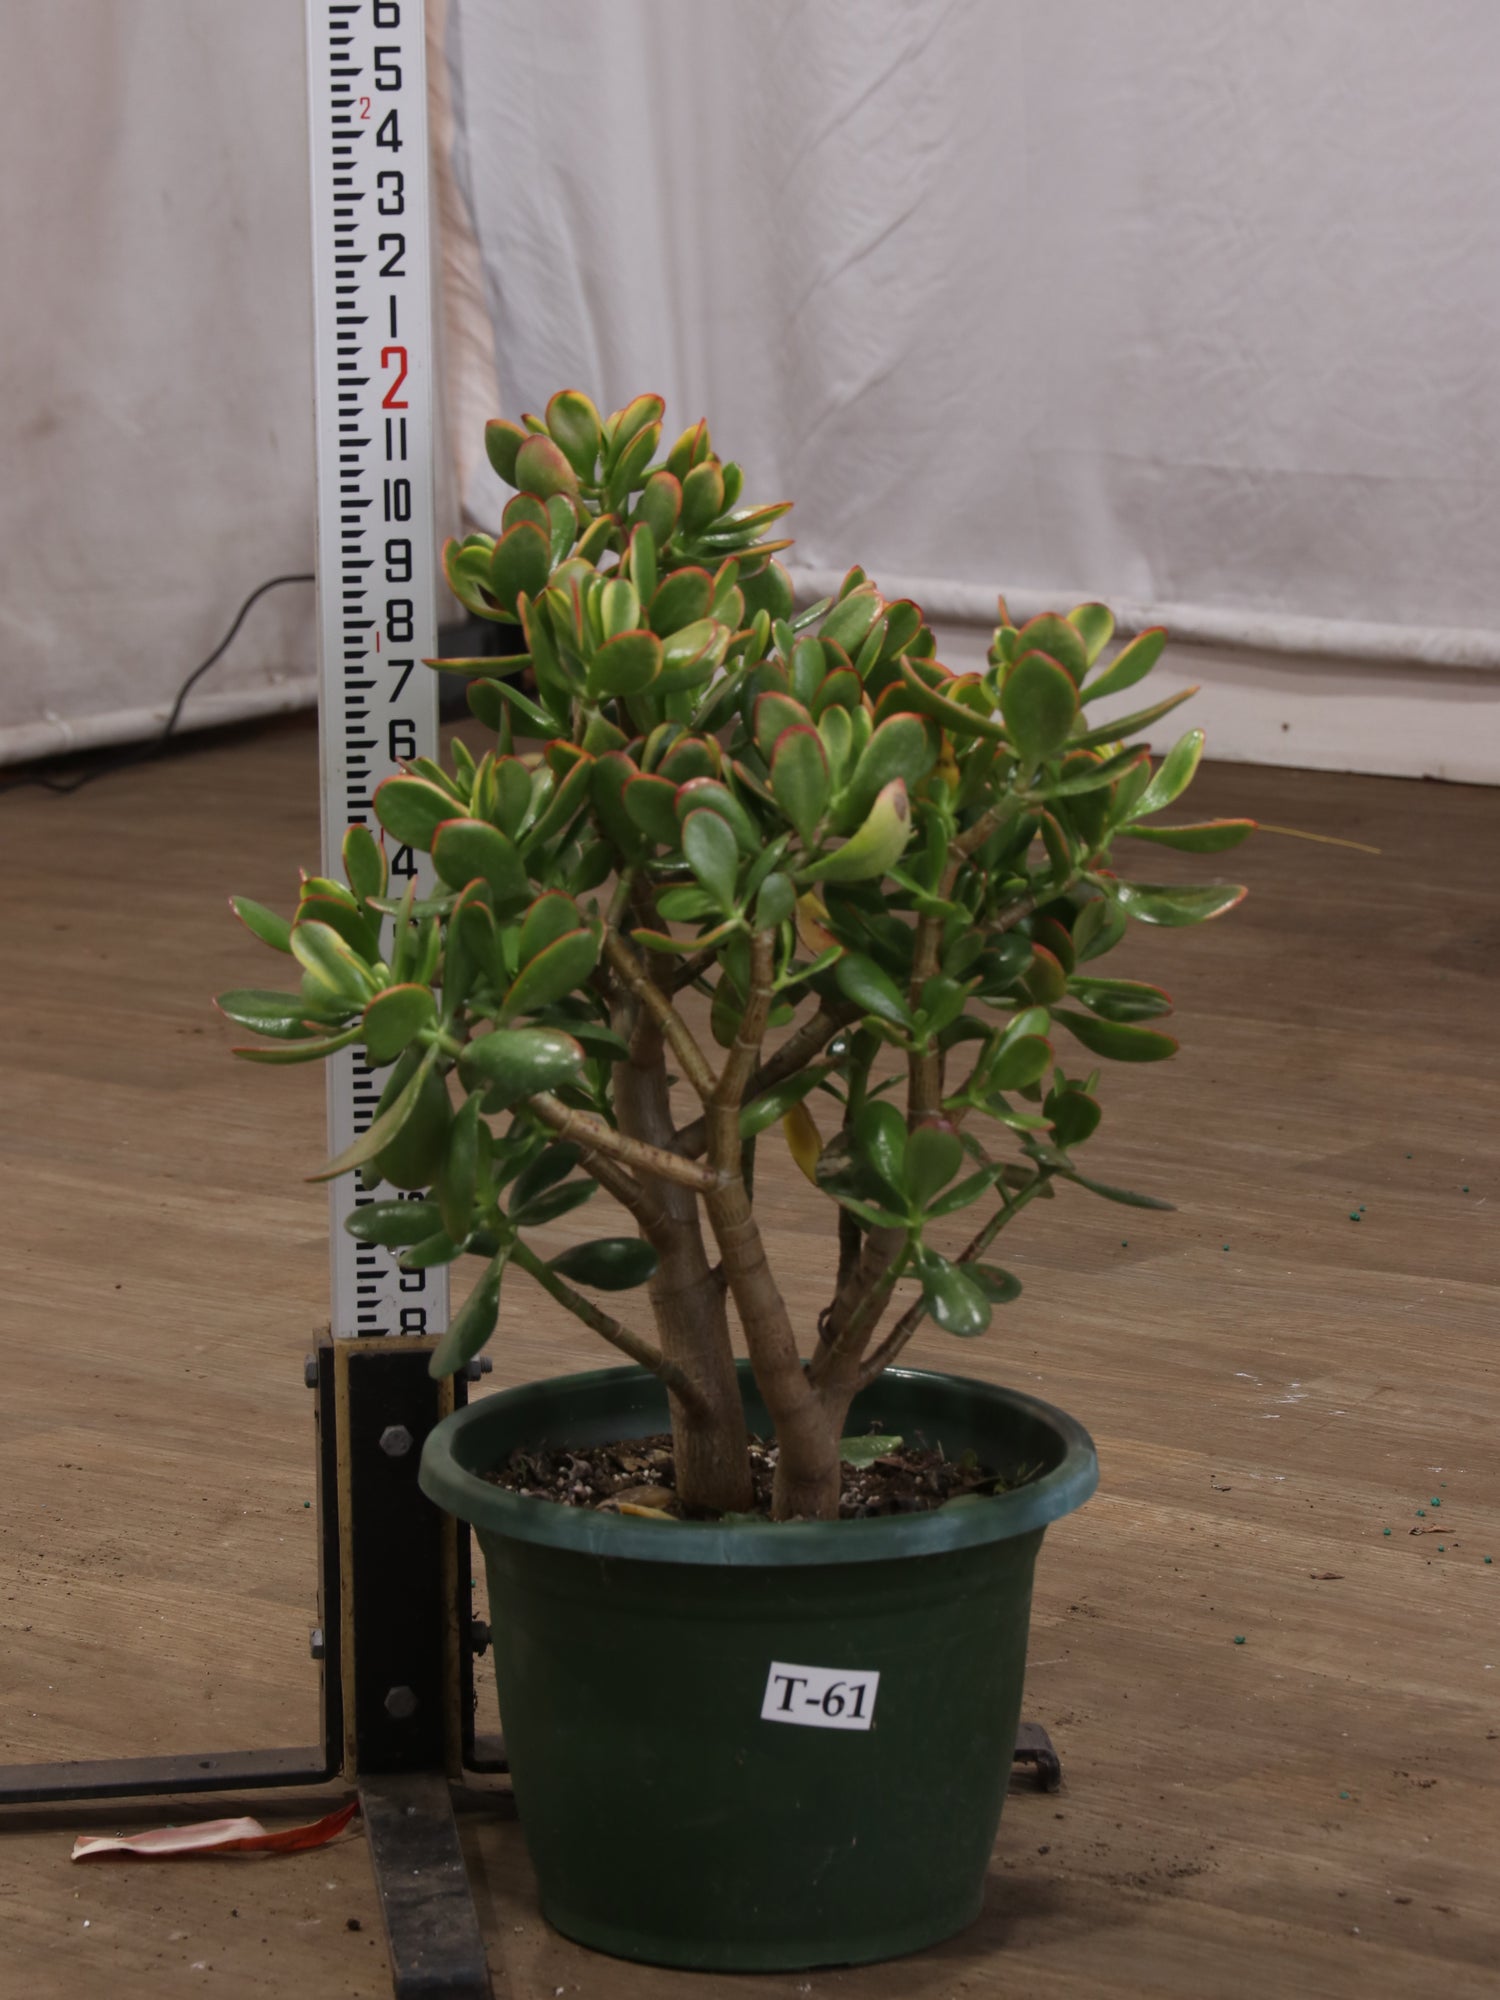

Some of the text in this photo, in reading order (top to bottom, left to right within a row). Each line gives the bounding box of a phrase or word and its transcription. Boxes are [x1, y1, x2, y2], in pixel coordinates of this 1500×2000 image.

[374, 46, 402, 91] 5
[359, 97, 371, 119] 2
[376, 109, 403, 152] 4
[377, 171, 404, 215] 3
[378, 233, 406, 277] 2
[381, 346, 408, 409] 2
[385, 417, 407, 460] 11
[384, 478, 411, 522] 10
[385, 538, 412, 582] 9
[386, 599, 413, 642] 8
[388, 659, 414, 703] 7
[388, 719, 416, 762] 6
[391, 843, 418, 881] 4
[774, 1675, 866, 1719] T-61
